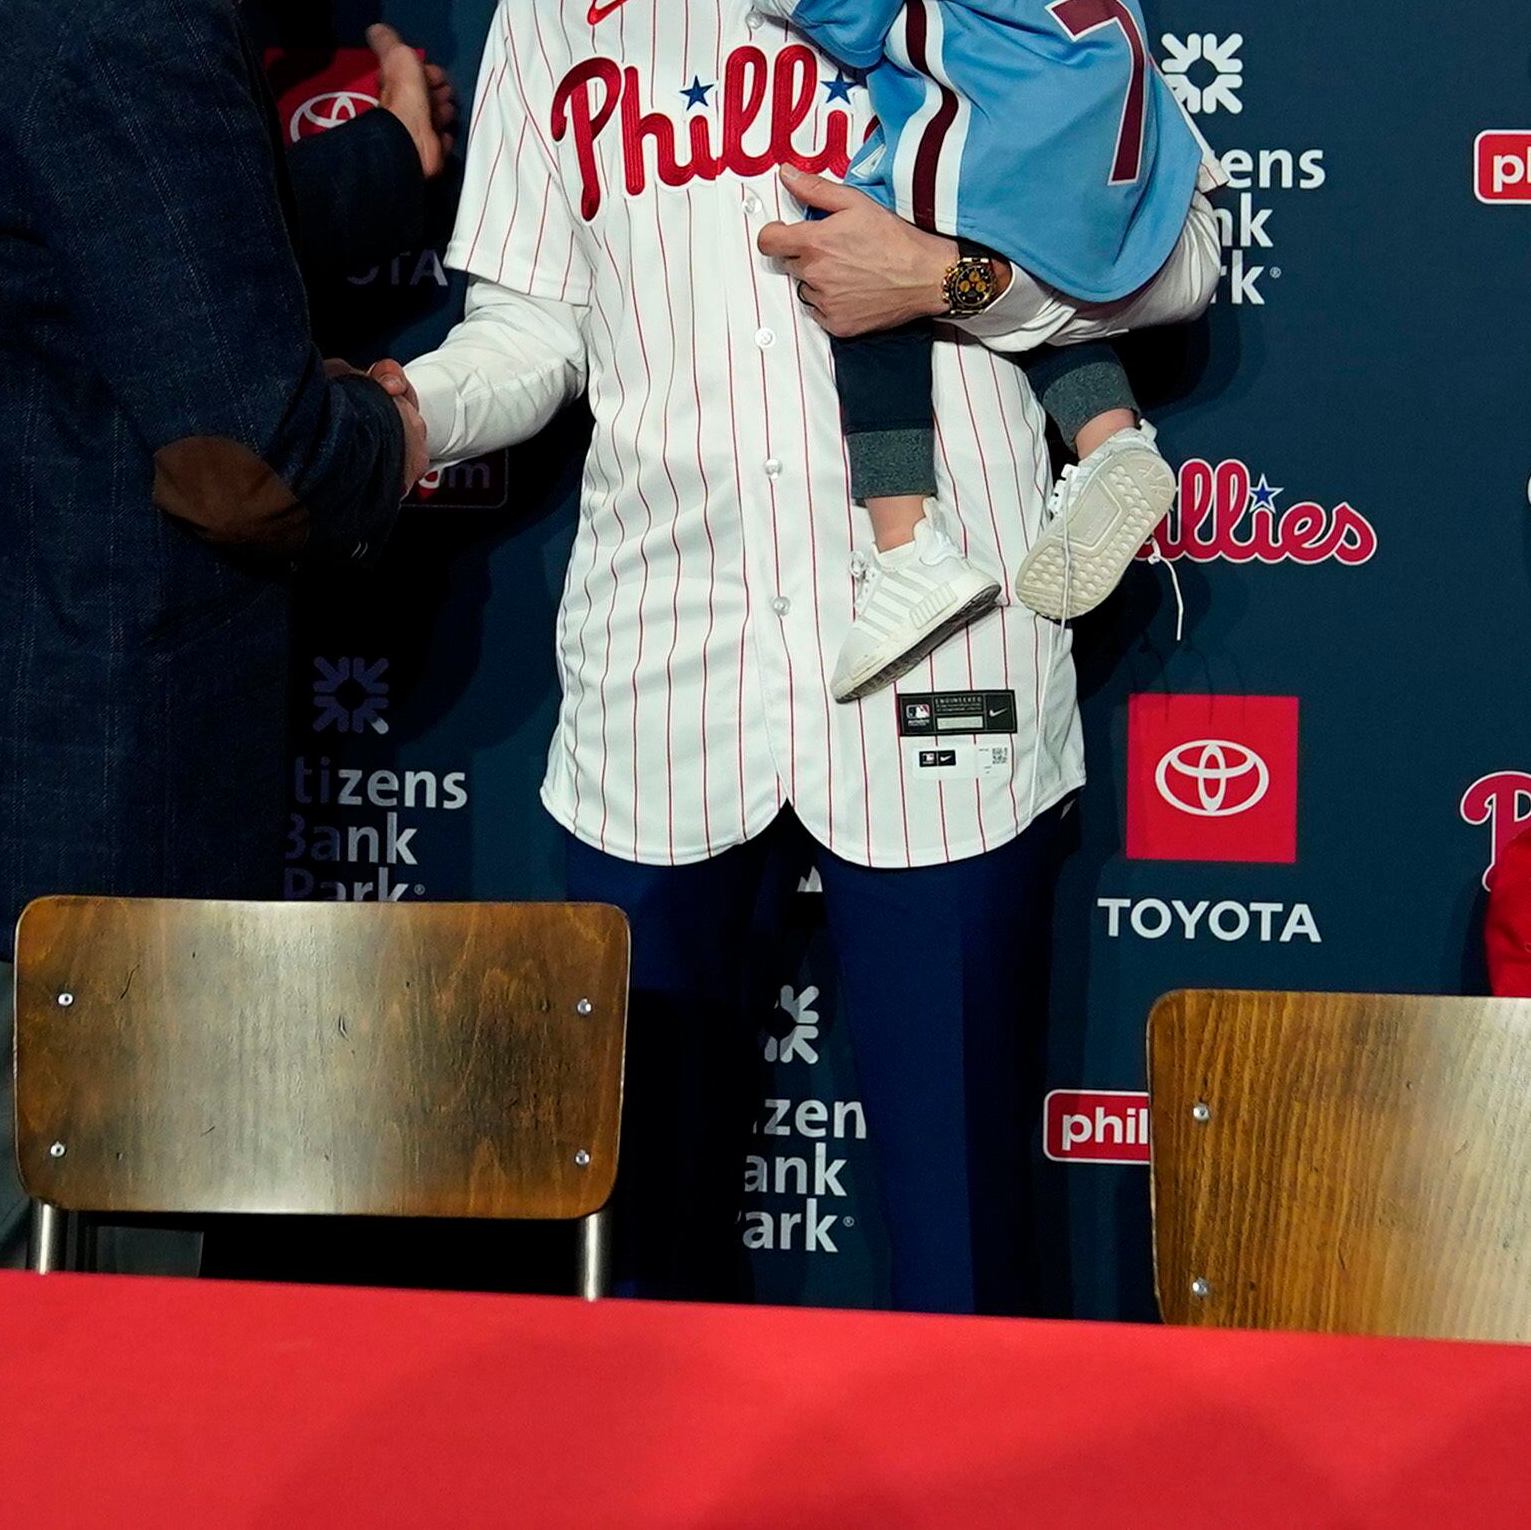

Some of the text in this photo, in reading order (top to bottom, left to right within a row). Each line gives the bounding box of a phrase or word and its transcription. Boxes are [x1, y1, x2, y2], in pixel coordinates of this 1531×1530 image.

[551, 44, 881, 221] Philli
[293, 755, 469, 810] tizens
[1098, 898, 1321, 942] TOYOTA
[743, 1142, 848, 1198] ank
[737, 1198, 839, 1254] ark
